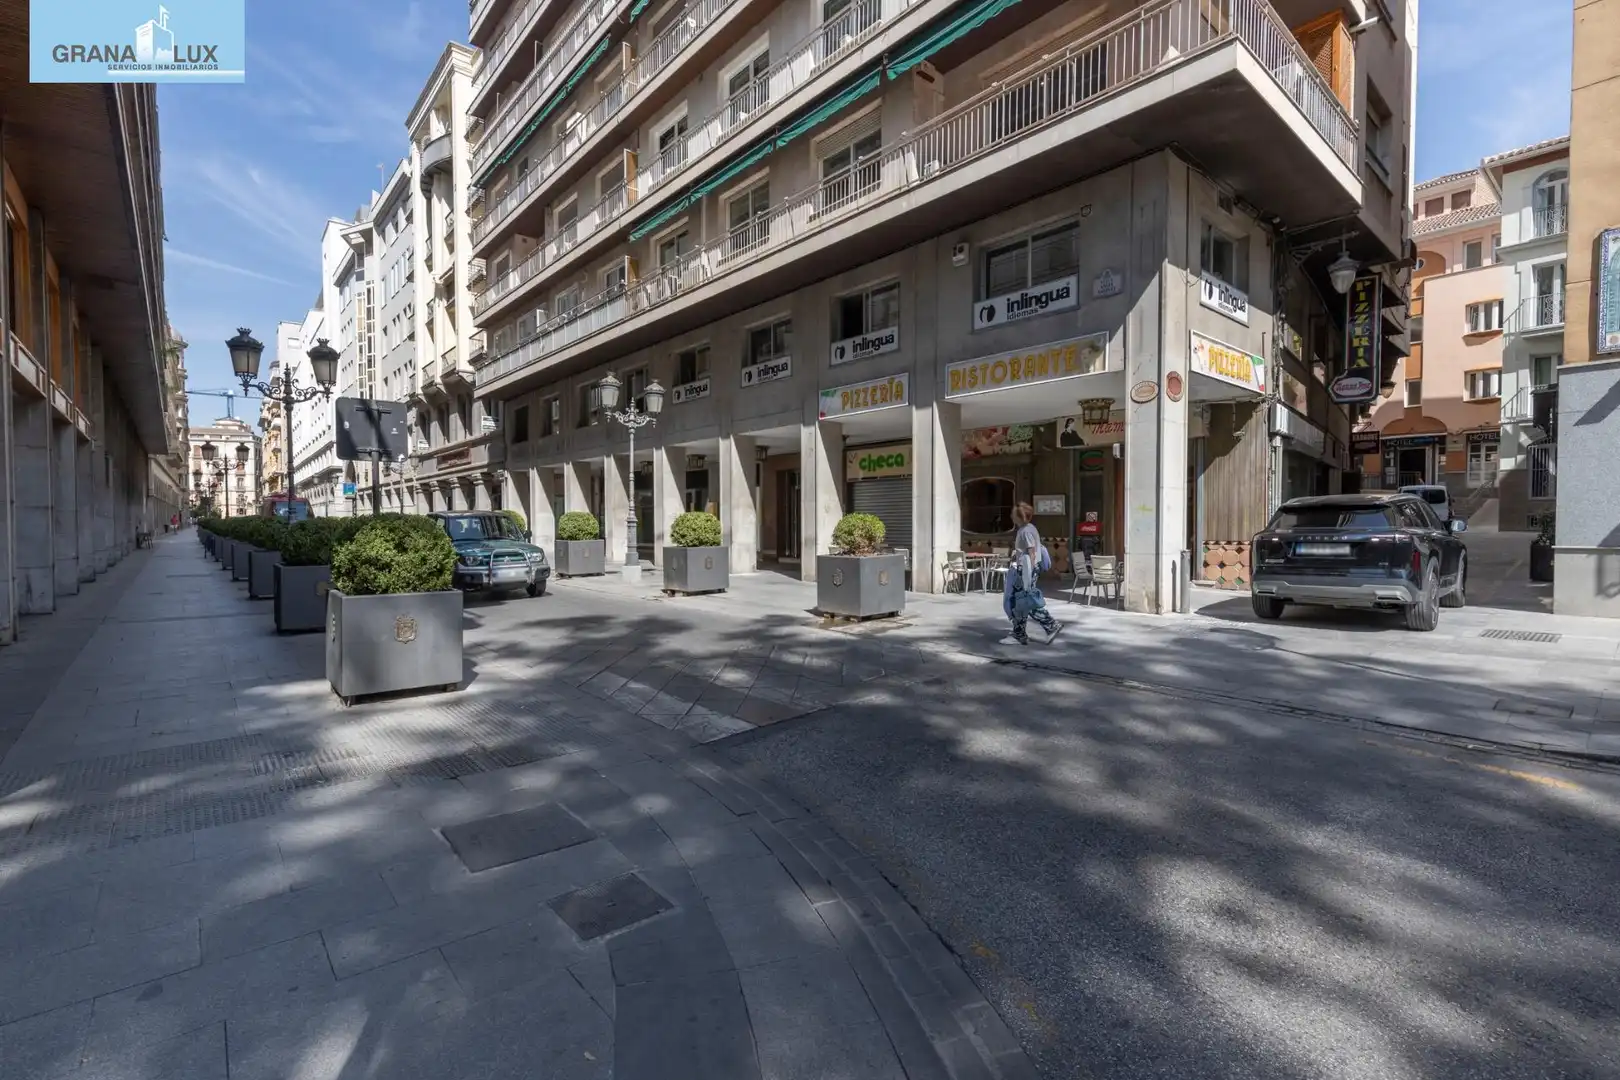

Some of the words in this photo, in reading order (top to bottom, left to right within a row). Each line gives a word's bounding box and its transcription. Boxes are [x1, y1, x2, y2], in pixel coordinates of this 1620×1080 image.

[1006, 285, 1071, 314] inlingua
[1218, 284, 1246, 313] inlingua
[1006, 306, 1039, 321] idiomas
[852, 332, 895, 354] inlingua
[757, 362, 788, 377] inlingua
[949, 344, 1081, 392] RISTORANTE
[684, 383, 708, 397] inlingua
[1469, 432, 1499, 441] HOTEL
[859, 453, 904, 471] checa
